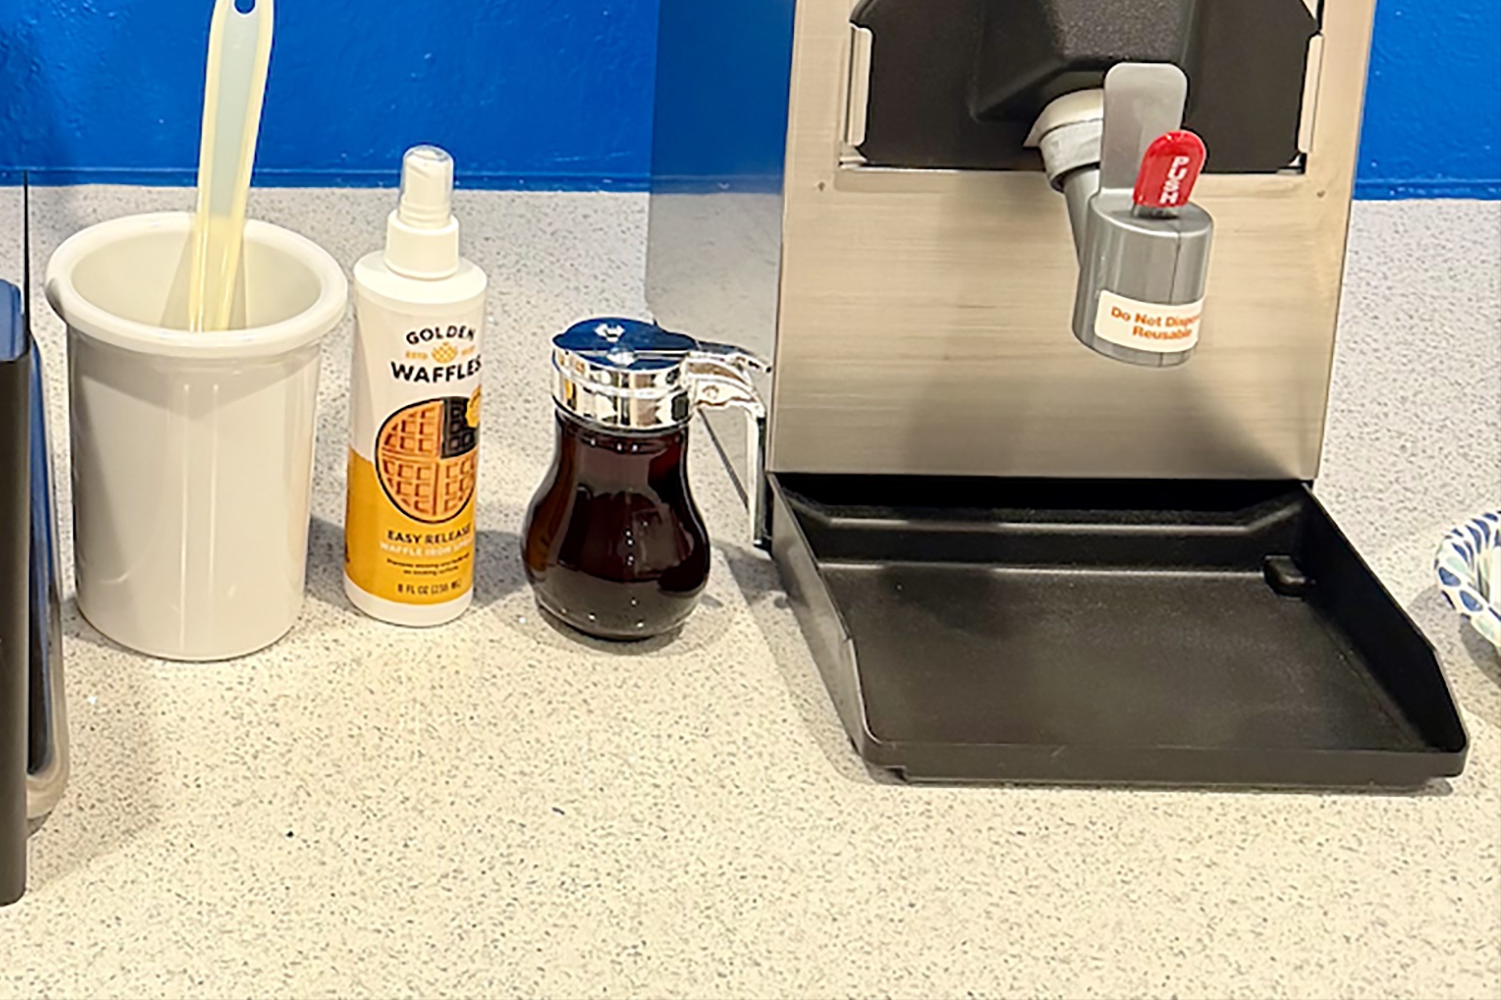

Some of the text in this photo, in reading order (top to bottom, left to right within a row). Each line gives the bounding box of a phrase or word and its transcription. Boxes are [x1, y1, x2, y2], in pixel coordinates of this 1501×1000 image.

[1159, 155, 1190, 204] PUSH
[1111, 305, 1131, 322] Do
[1134, 313, 1161, 327] Not
[406, 325, 475, 345] GOLDEN
[390, 354, 481, 383] WAFFLES
[388, 530, 421, 544] EASY
